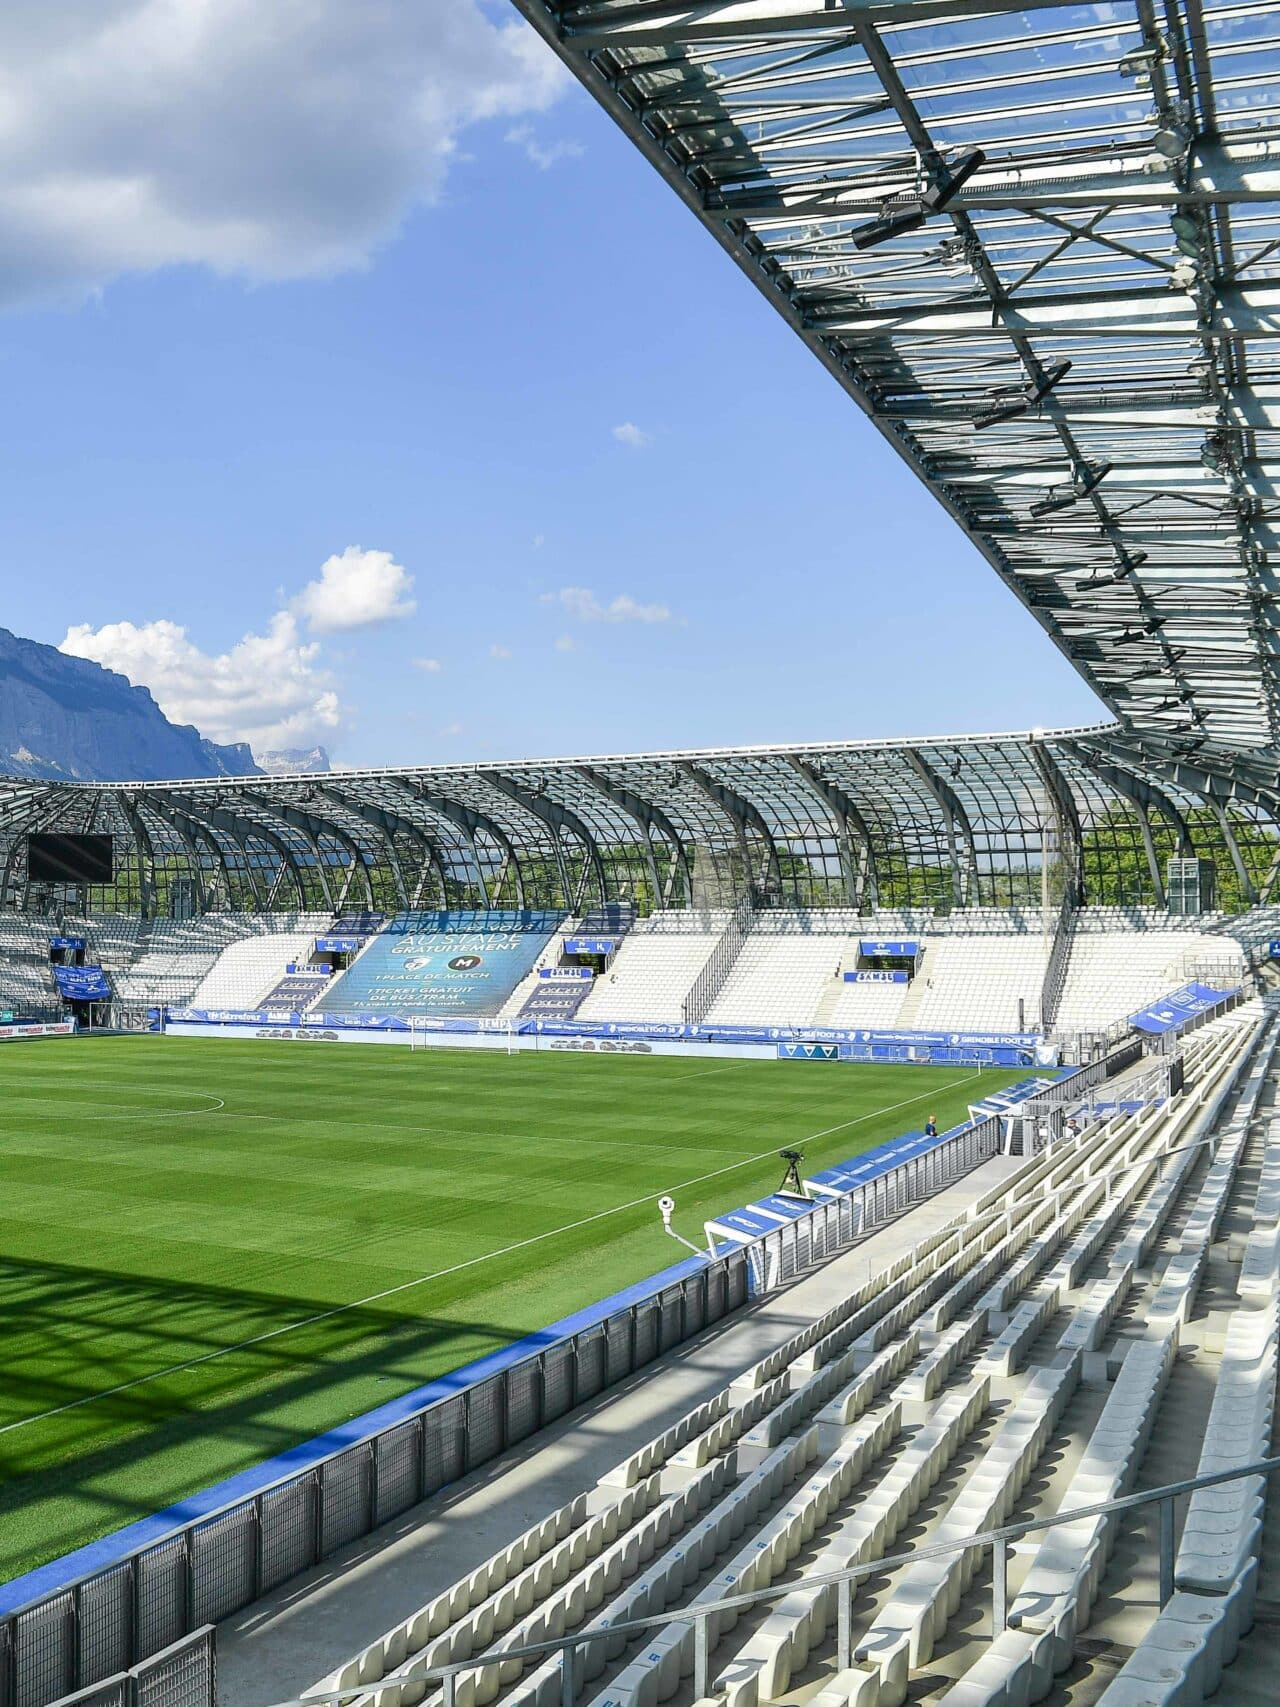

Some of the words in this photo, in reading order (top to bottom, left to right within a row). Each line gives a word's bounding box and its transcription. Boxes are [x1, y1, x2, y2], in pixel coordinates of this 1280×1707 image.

[398, 934, 435, 947] AU
[440, 932, 524, 946] STADE
[391, 943, 521, 954] GRATUITEMENT
[455, 958, 474, 967] M
[961, 1036, 1000, 1045] GRENOBLE
